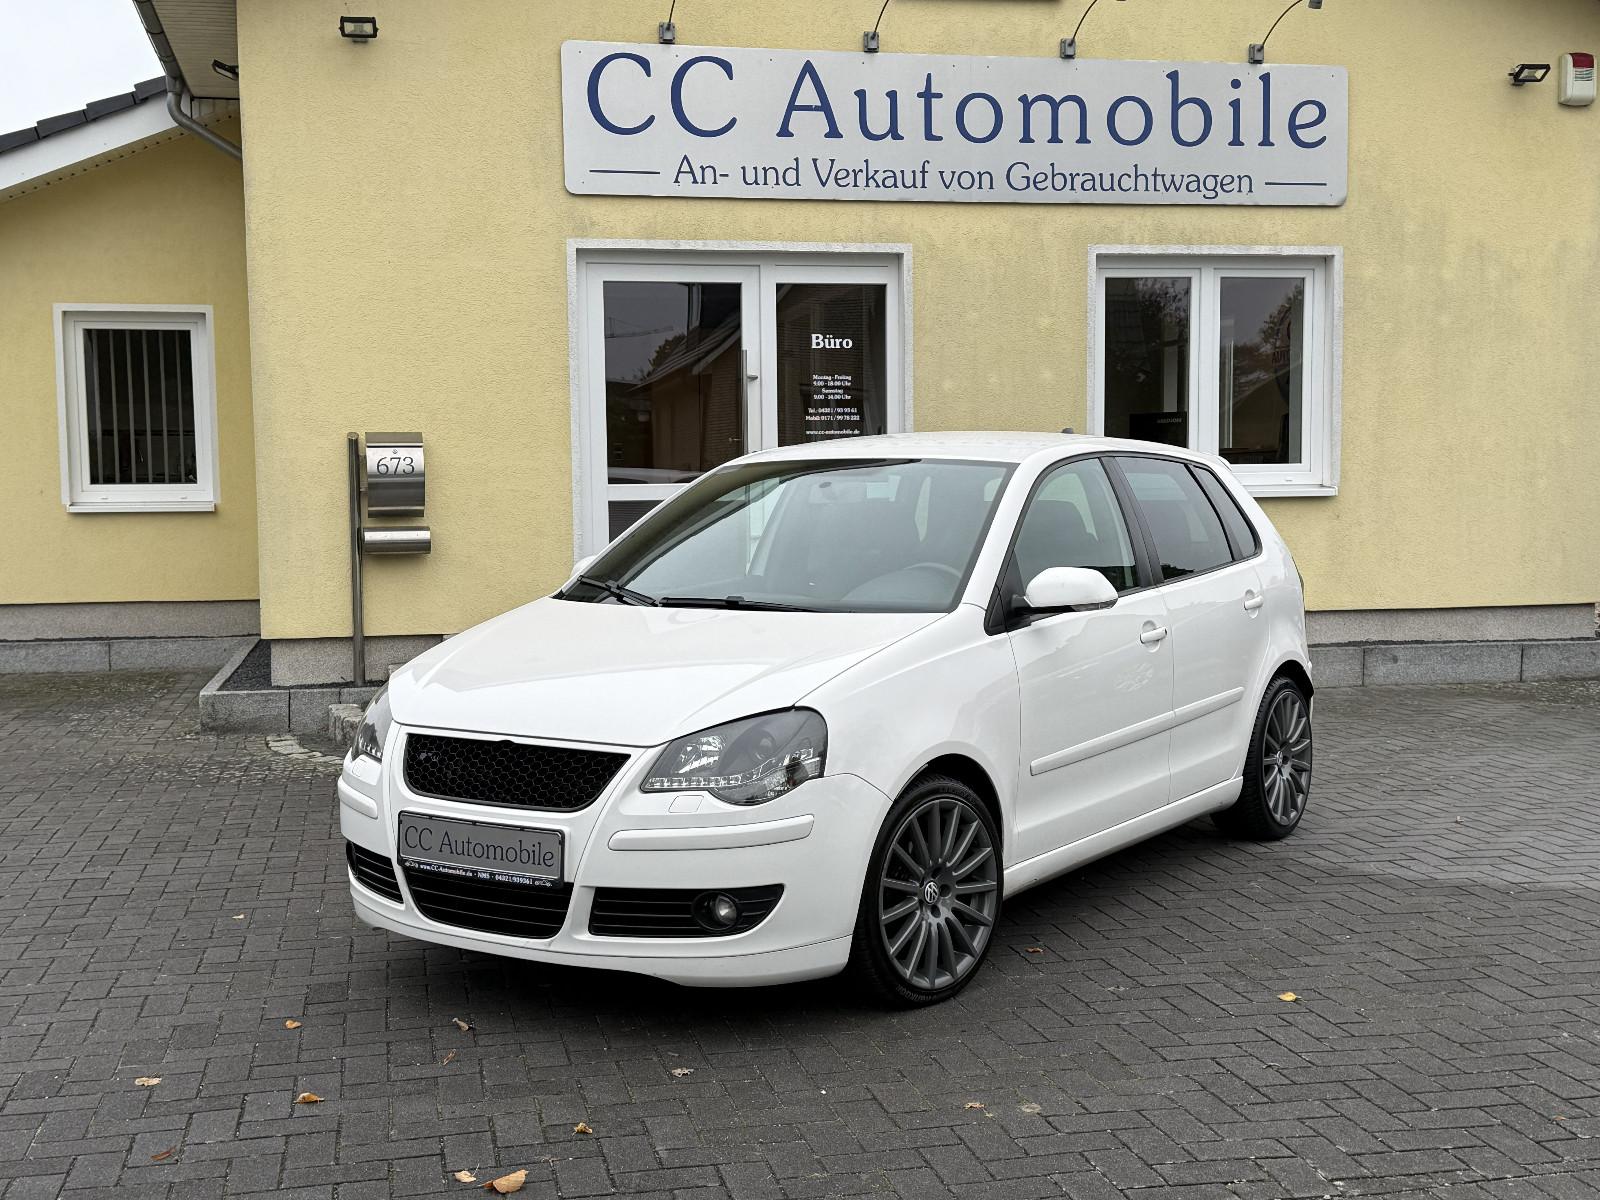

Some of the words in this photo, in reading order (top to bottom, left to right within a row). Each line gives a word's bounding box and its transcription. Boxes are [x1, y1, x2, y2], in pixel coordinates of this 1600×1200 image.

[587, 52, 737, 138] CC
[776, 59, 1327, 149] Automobile
[673, 154, 729, 185] An-
[741, 157, 801, 187] und
[812, 158, 931, 189] Verkauf
[939, 170, 994, 190] von
[1005, 162, 1254, 200] Gebrauchtwagen
[811, 333, 853, 349] Büro
[376, 456, 415, 476] 673
[404, 826, 433, 851] CC
[439, 830, 555, 868] Automobile
